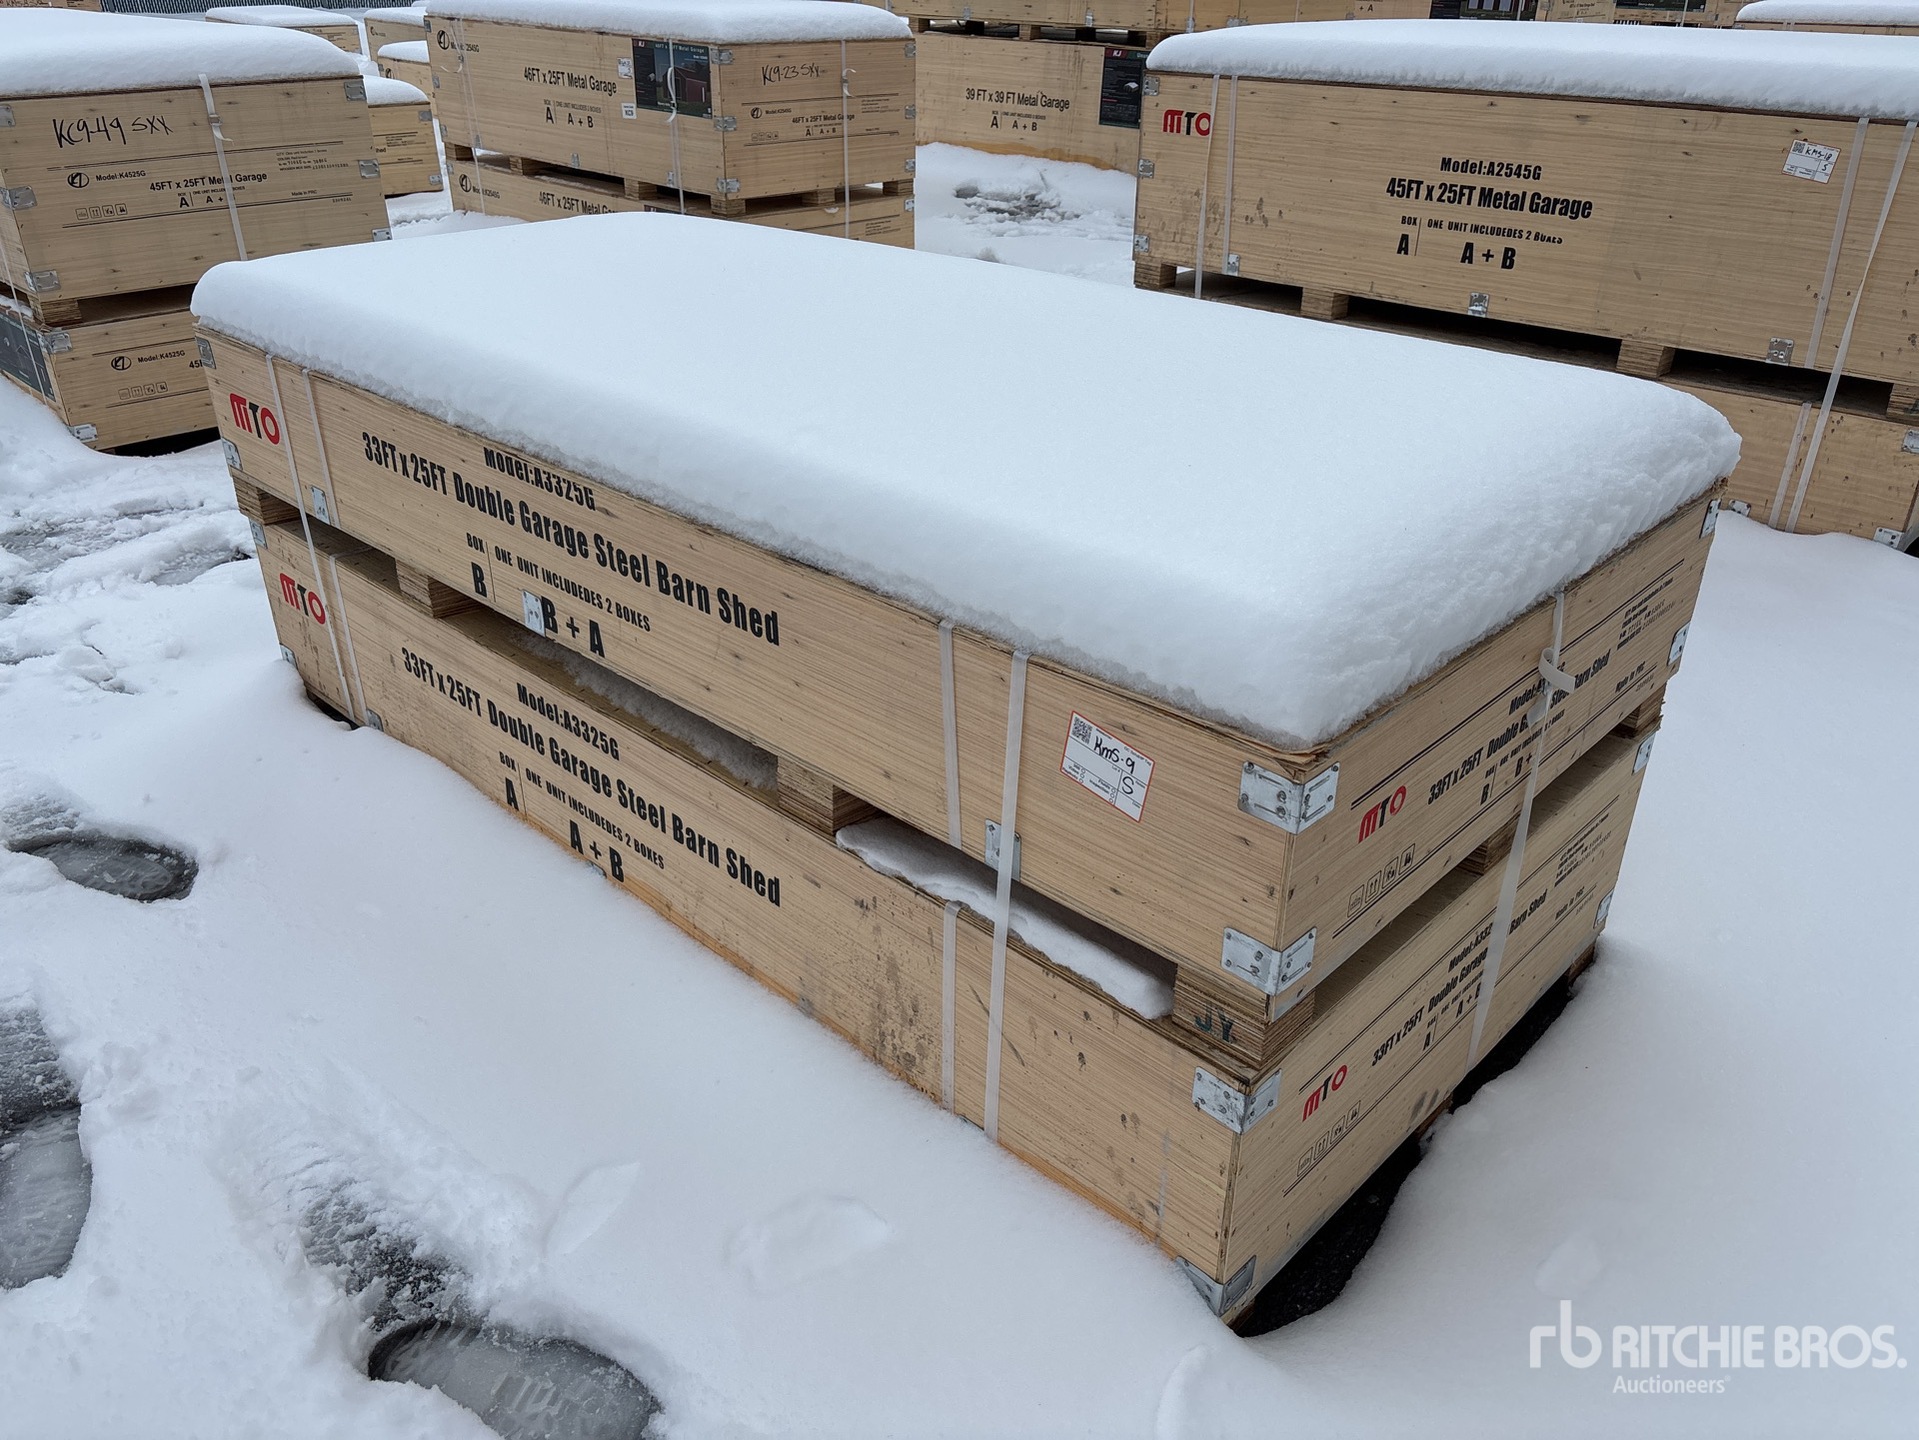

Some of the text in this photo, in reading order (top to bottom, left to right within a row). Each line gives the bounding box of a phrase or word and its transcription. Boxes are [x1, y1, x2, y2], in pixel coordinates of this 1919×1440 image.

[1367, 4, 1373, 12] A
[524, 67, 617, 96] 46FT x 25FT Metal Garage
[965, 88, 1070, 112] 39 FT x 39 FT Metal Garage
[546, 107, 554, 124] A
[568, 113, 574, 125] A
[588, 116, 593, 128] B
[991, 116, 998, 128] A
[1012, 120, 1018, 129] A
[1031, 122, 1037, 131] B
[1163, 109, 1212, 136] MTO
[96, 170, 146, 182] Model:K4525G
[149, 171, 267, 192] 45FT x 25FT Garage
[1440, 157, 1542, 180] Model:A2545G
[179, 197, 189, 208] A
[206, 195, 213, 204] A
[563, 196, 580, 212] 25FT
[1386, 177, 1593, 220] 45FT x 25FT Metal Garage
[1401, 215, 1417, 226] BOX
[1427, 218, 1443, 229] ONE
[1448, 221, 1469, 232] UNIT
[1470, 223, 1523, 240] INCLUDEDES
[1525, 230, 1532, 240] 2
[1397, 234, 1409, 255] A
[1460, 242, 1516, 269] A + B
[229, 393, 280, 445] MTO
[362, 432, 779, 646] 33FT x 25FT Double Garage Steel Barn Shed
[466, 532, 651, 632] BOX ONE UNIT INCLUDEDES 2 BOXES
[471, 562, 487, 598] B
[279, 573, 326, 625] MTO
[541, 595, 606, 658] B + A
[517, 682, 620, 761] Model:A3325G
[1428, 770, 1453, 805] 33FT
[1452, 768, 1460, 787] x
[1459, 747, 1483, 781] 25FT
[1487, 721, 1519, 759] Double
[1591, 648, 1611, 678] Shed
[402, 646, 780, 907] 33FT x 25FT Double Garage Steel Barn Shed
[1515, 756, 1523, 778] B
[505, 777, 519, 811] A
[1122, 776, 1134, 794] S
[1481, 783, 1489, 805] B
[499, 750, 665, 870] BOX ONE UNIT INCLUDEDES 2 BOXES
[1358, 785, 1407, 844] MTO
[569, 819, 624, 883] A + B
[1372, 1033, 1395, 1066] 33FT
[1395, 1031, 1401, 1045] x
[1402, 1005, 1425, 1039] 25FT
[1428, 975, 1458, 1013] Double
[1528, 888, 1548, 917] Shed
[1456, 999, 1463, 1018] A
[1423, 1031, 1431, 1051] A
[1302, 1065, 1348, 1122] MTO
